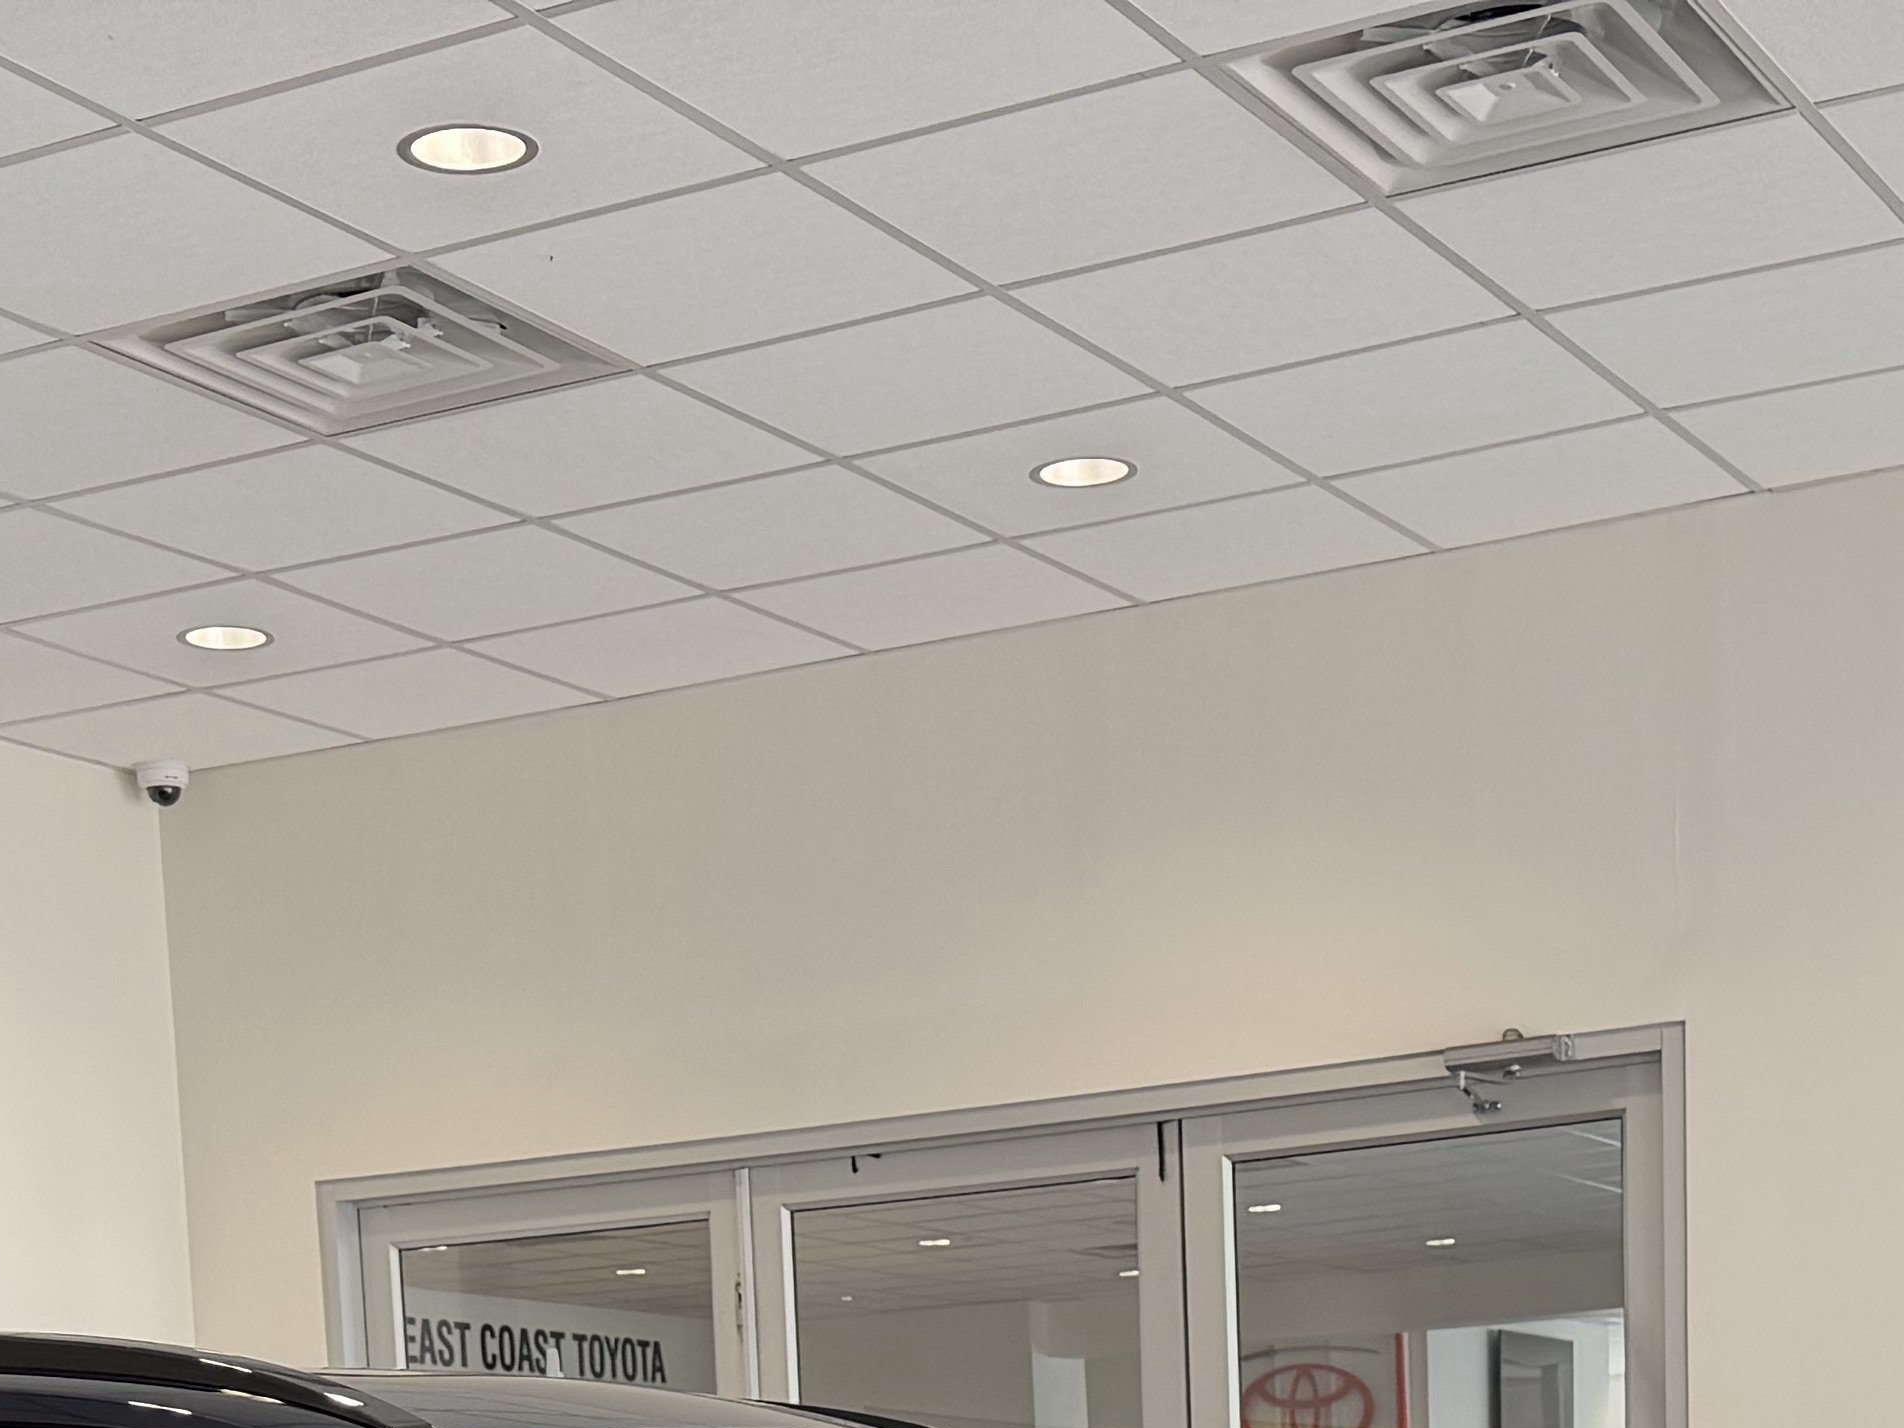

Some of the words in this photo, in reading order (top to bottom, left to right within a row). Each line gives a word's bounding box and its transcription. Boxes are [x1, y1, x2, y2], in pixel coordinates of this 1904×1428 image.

[405, 1316, 471, 1368] EAST
[480, 1322, 566, 1376] COAST
[572, 1332, 668, 1384] TOYOTA
